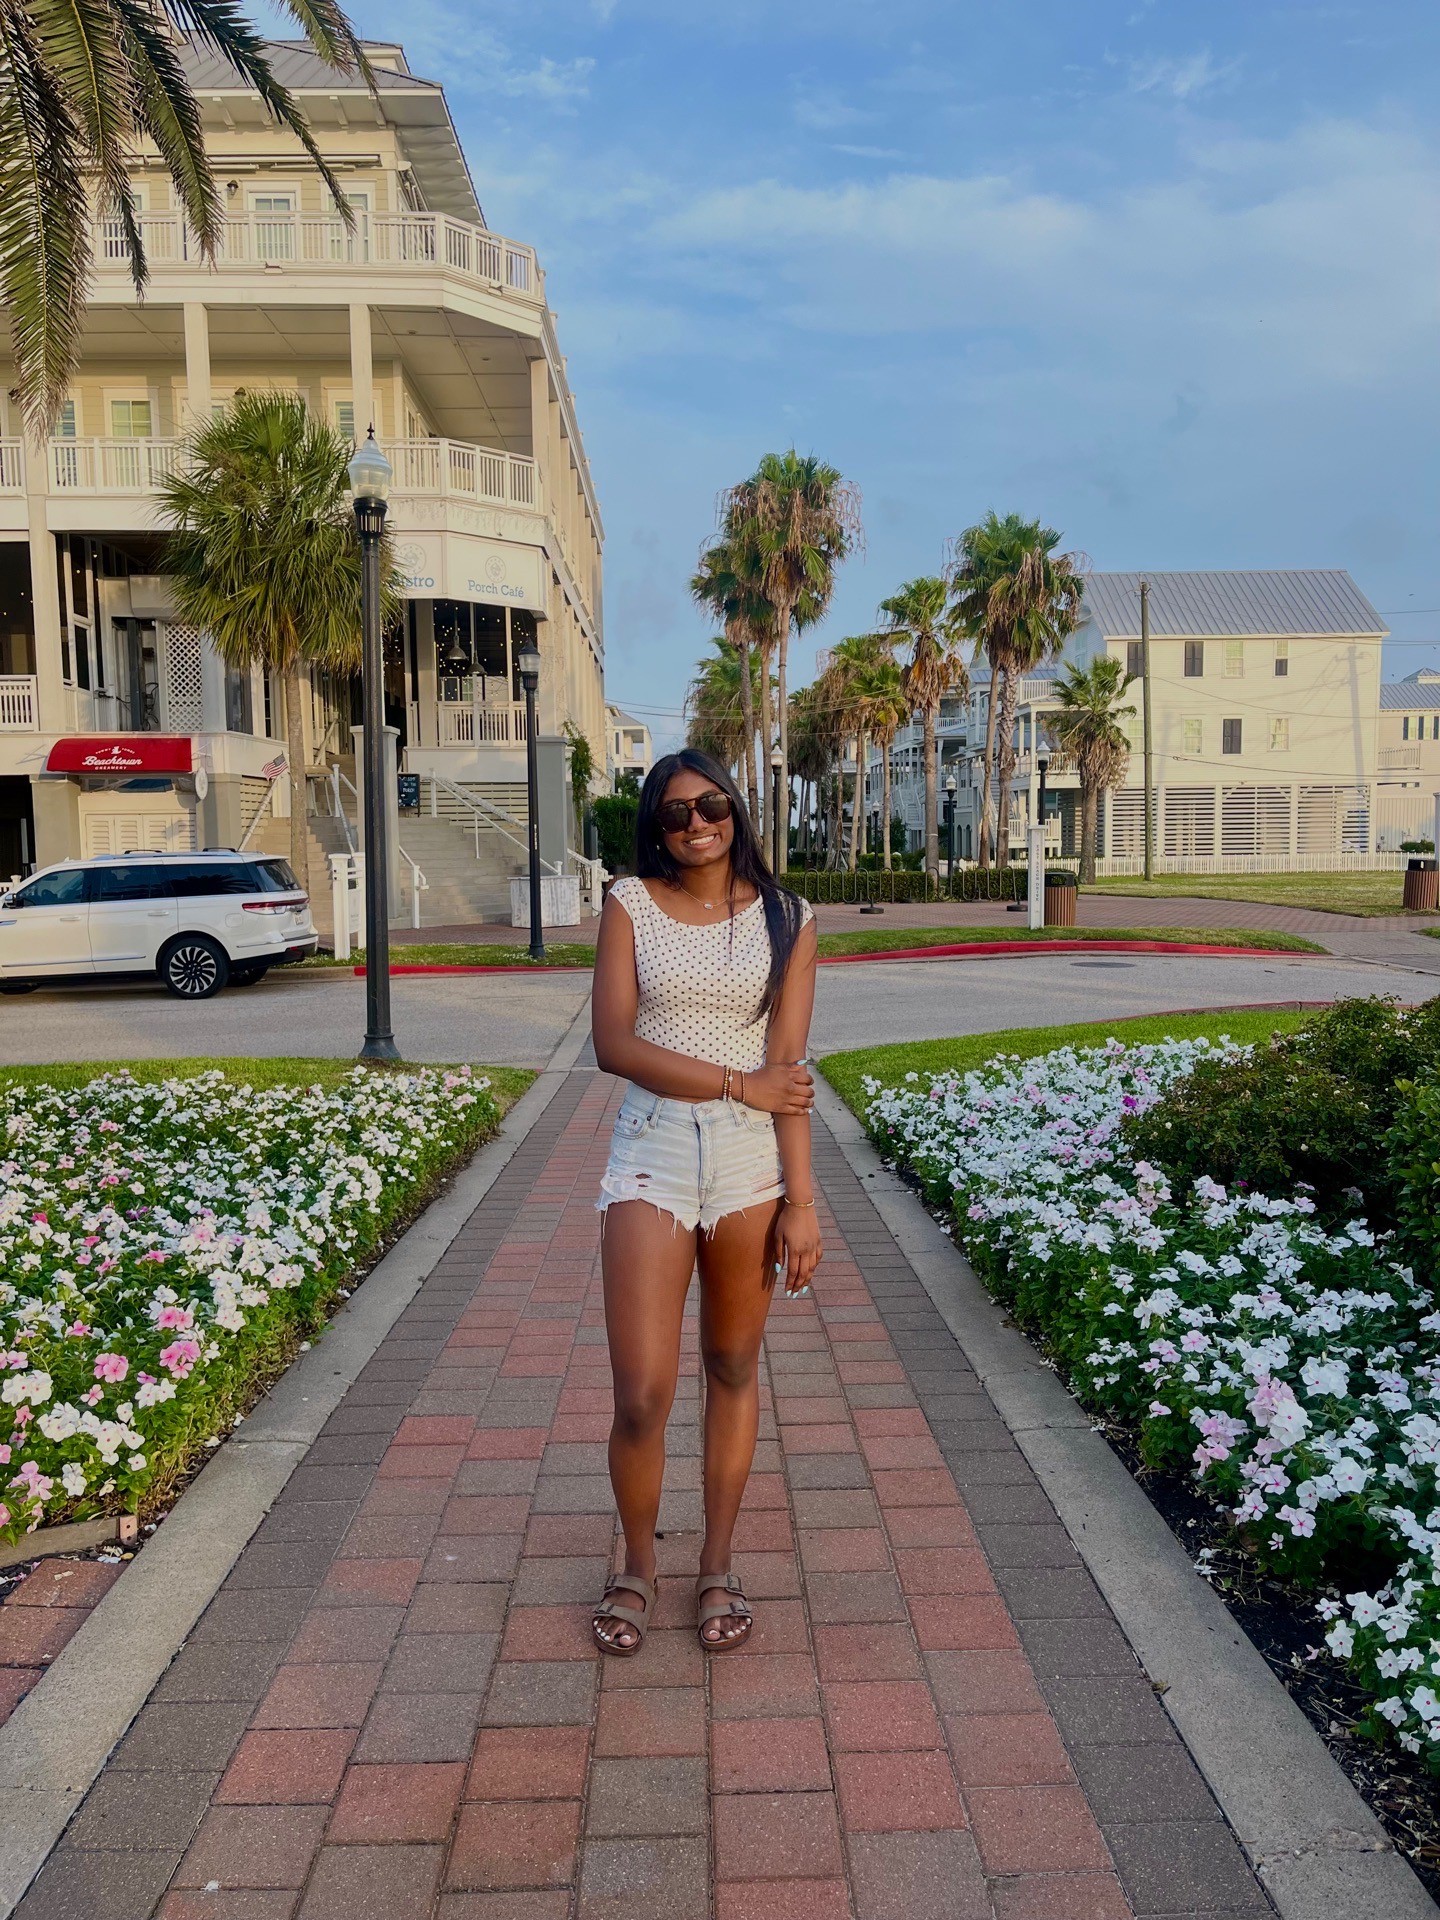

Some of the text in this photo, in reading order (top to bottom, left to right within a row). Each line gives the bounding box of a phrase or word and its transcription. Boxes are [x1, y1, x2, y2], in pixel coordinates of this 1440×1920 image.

[467, 579, 525, 598] Porch Café
[82, 756, 142, 765] Beachtown
